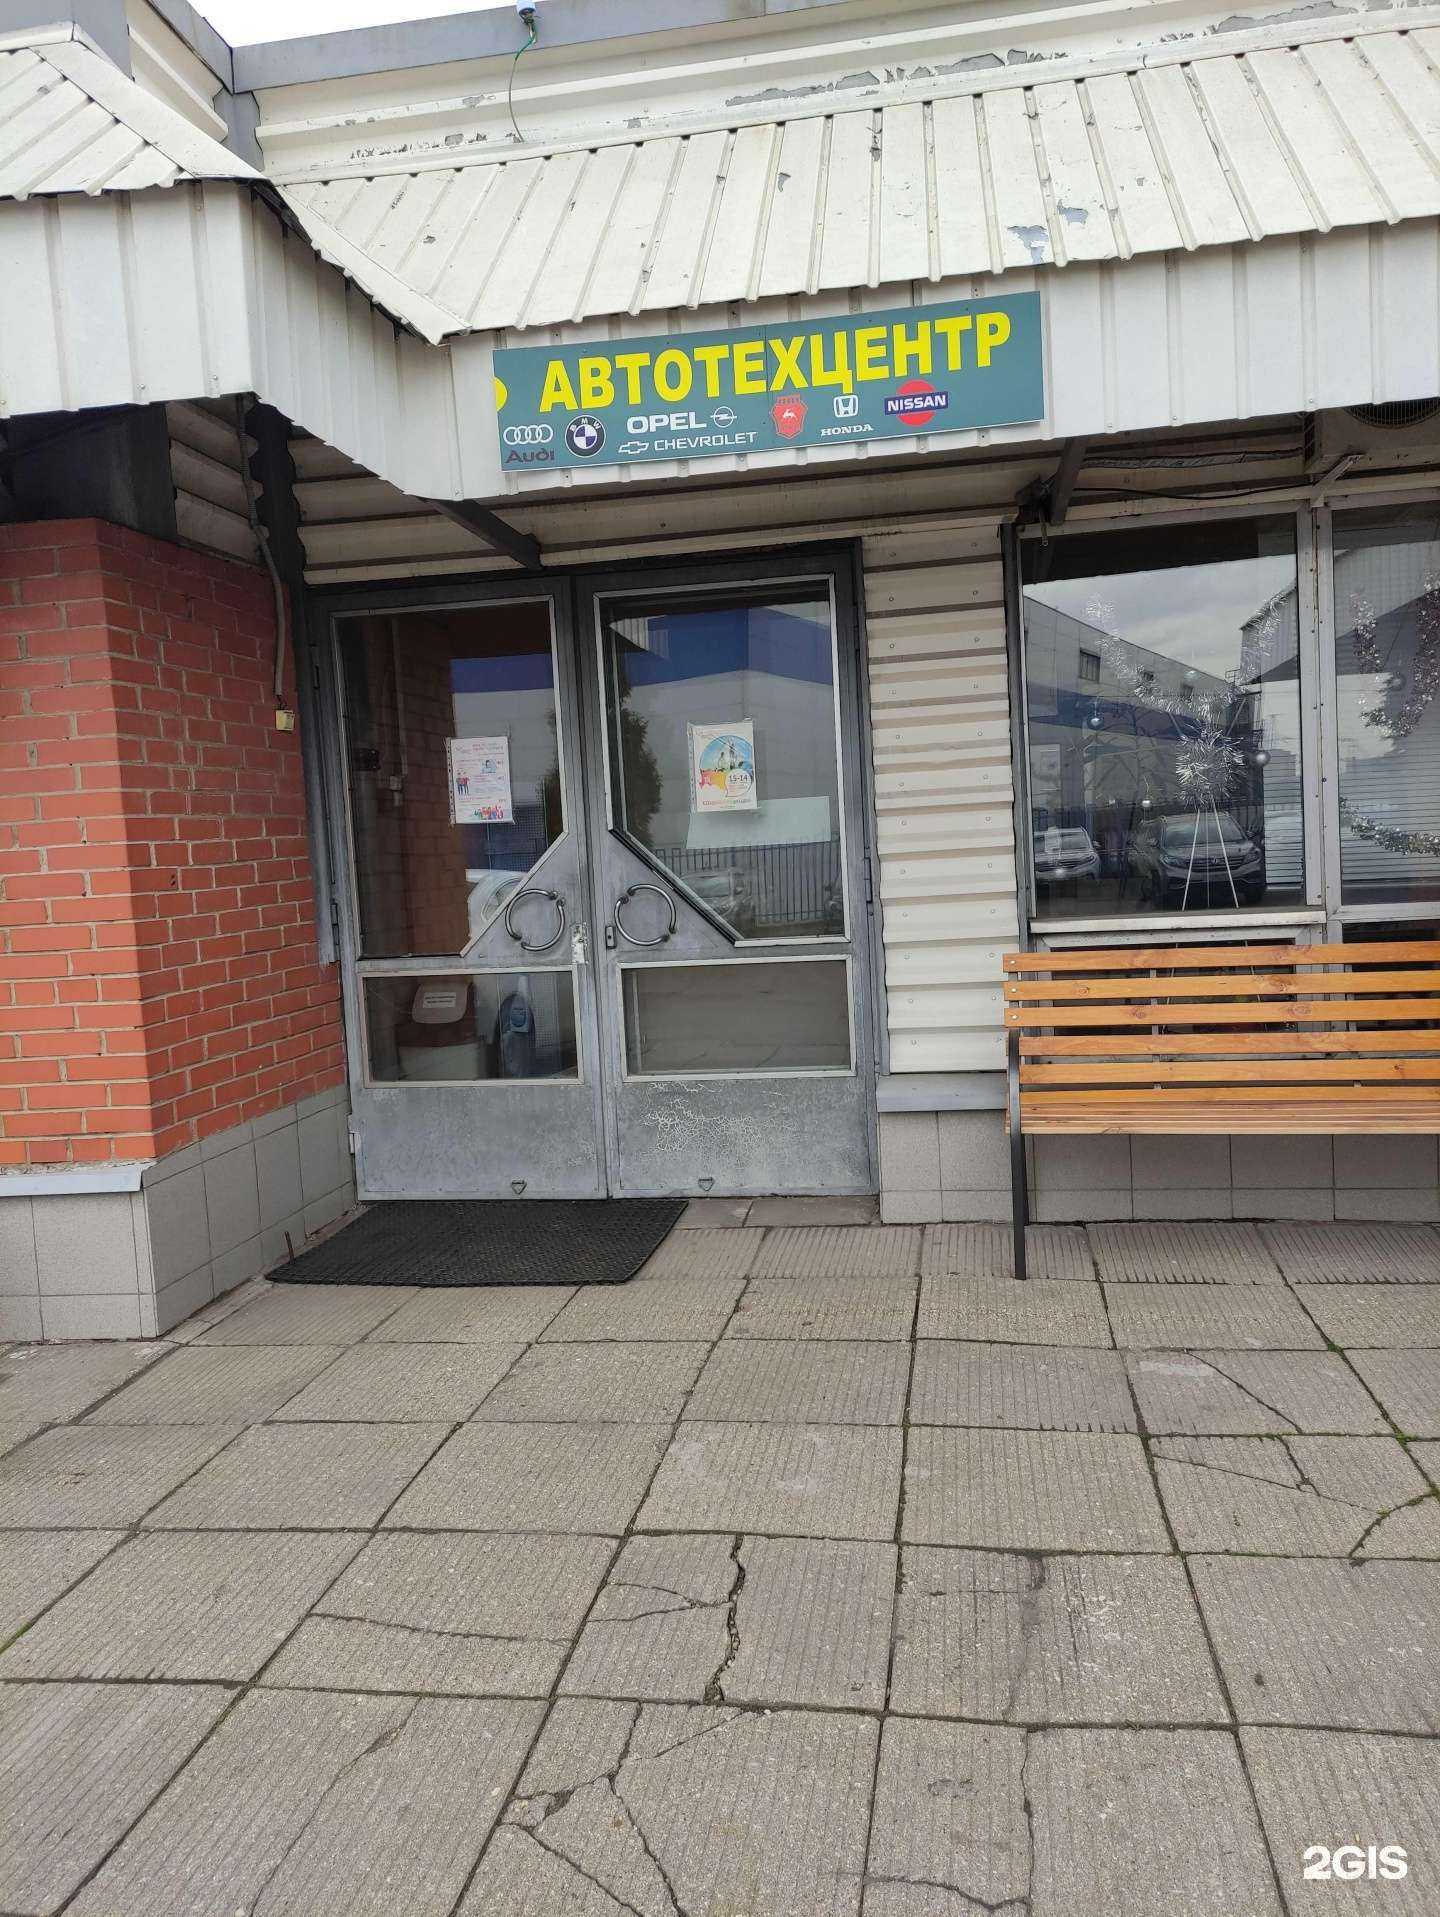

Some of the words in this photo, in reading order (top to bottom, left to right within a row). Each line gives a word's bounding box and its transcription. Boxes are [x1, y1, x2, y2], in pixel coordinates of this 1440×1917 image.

[539, 311, 1011, 412] АВТОТЕХЦЕНТР
[887, 394, 947, 412] NISSAN
[626, 411, 707, 434] OPEL
[820, 423, 874, 437] HONDA
[654, 431, 758, 451] CHEVROLET
